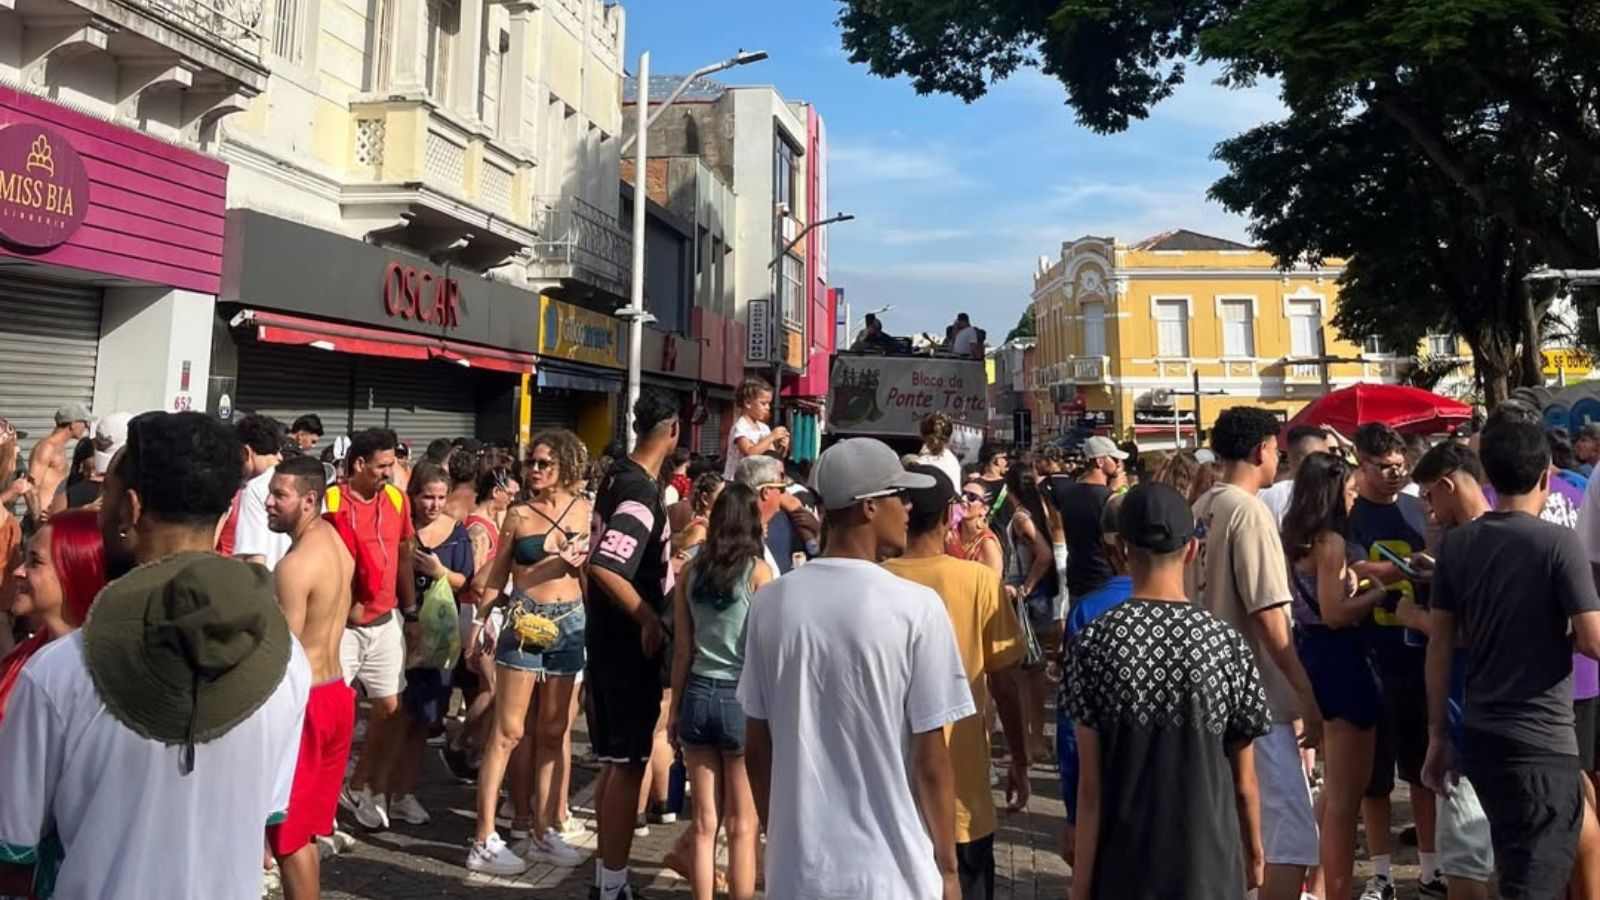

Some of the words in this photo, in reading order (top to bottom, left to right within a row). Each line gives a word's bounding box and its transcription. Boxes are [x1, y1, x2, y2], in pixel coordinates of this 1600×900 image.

[0, 170, 43, 208] MISS
[46, 183, 73, 216] BIA
[384, 262, 459, 328] OSCAR
[912, 371, 944, 387] Bloco
[174, 396, 192, 411] 652
[886, 386, 933, 408] Ponte
[600, 529, 638, 560] 36
